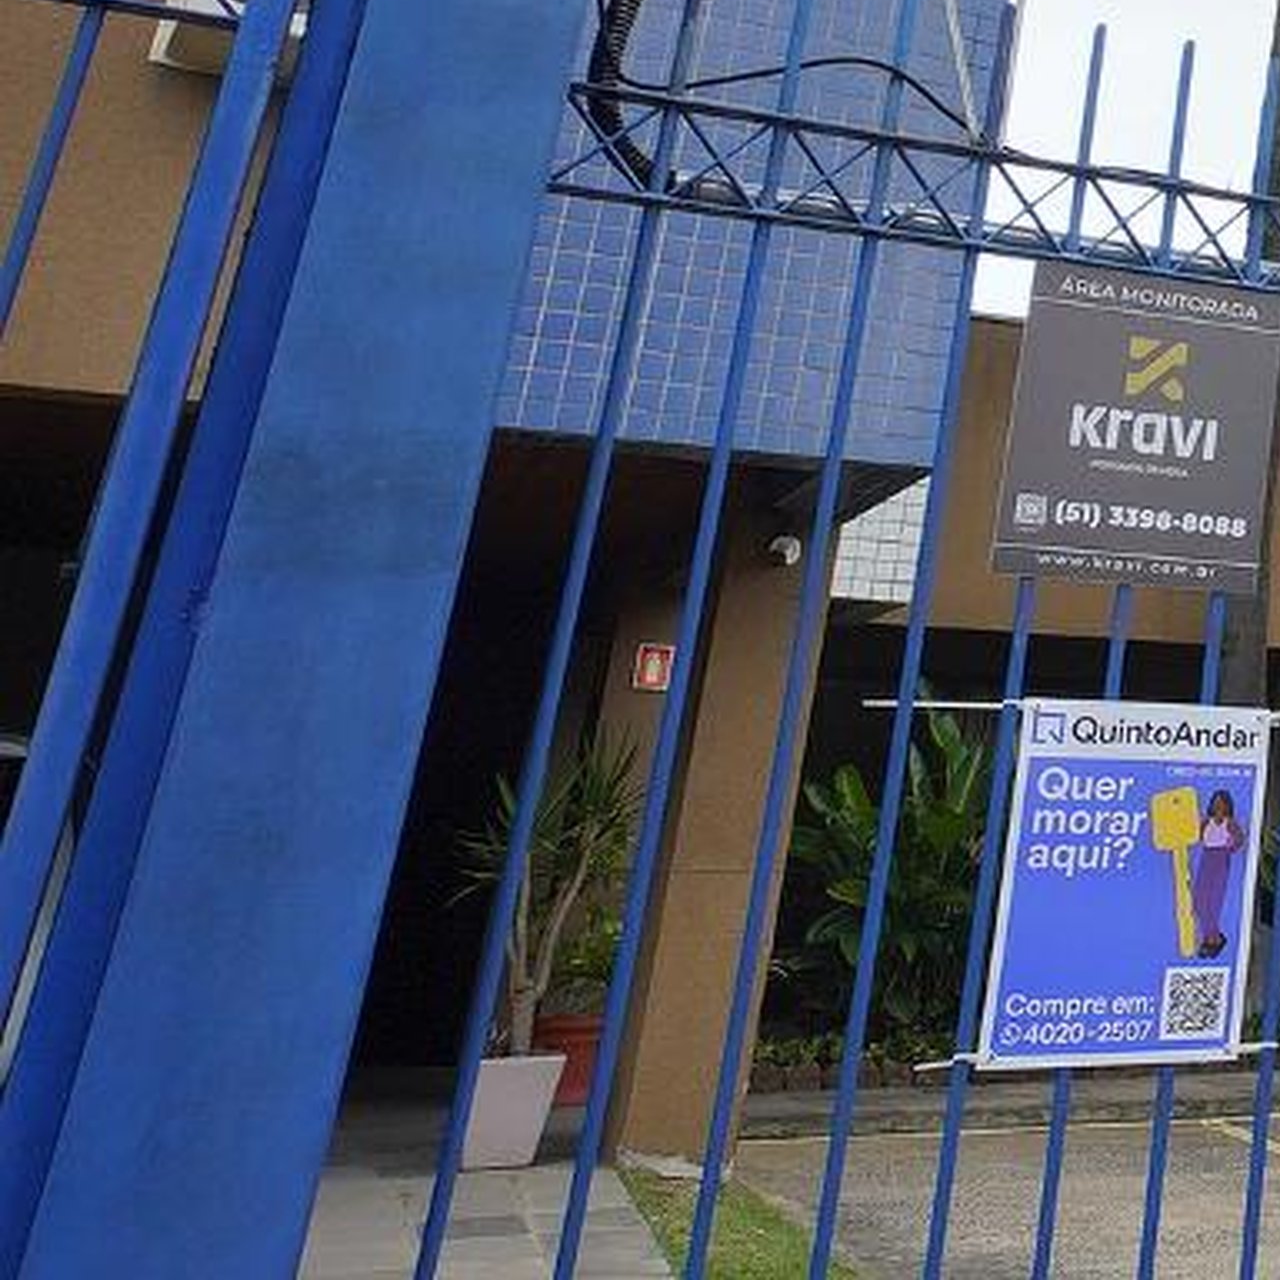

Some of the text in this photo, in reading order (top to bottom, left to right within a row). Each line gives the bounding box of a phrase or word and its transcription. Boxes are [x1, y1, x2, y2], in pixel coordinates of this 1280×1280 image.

[1121, 285, 1259, 320] MONITORADA
[1055, 498, 1248, 537] (51) 3398-8088
[1071, 715, 1261, 750] QuintoAndar
[1038, 765, 1135, 802] Quer
[1031, 807, 1148, 836] morar
[1027, 835, 1135, 876] aqui?
[1005, 993, 1105, 1019] Compre
